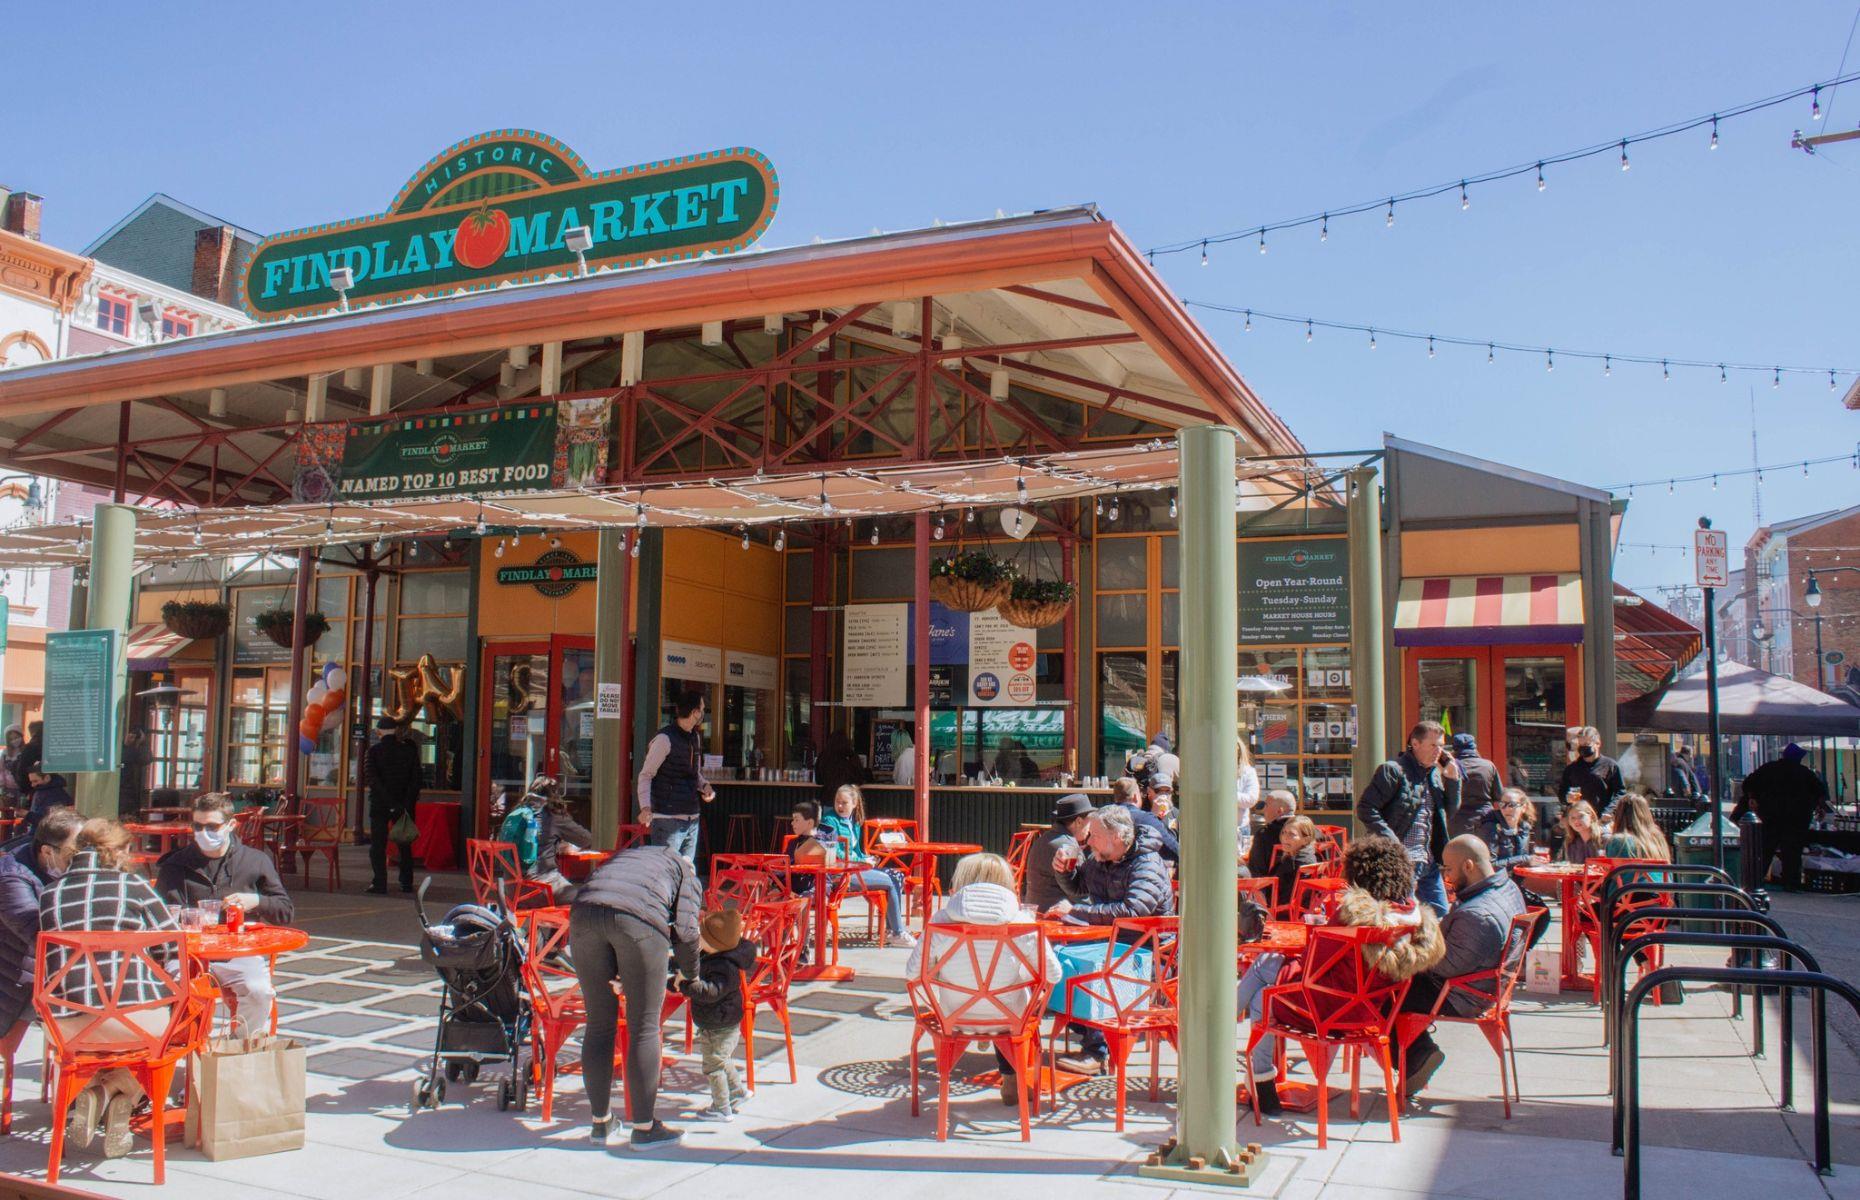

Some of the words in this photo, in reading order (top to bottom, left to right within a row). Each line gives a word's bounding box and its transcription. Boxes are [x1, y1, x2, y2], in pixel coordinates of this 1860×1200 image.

[424, 147, 554, 196] HISTORIC
[261, 229, 458, 299] FINDLAY
[504, 177, 749, 258] MARKET
[402, 445, 441, 456] FINDLAY
[449, 441, 488, 453] MARKET
[340, 475, 399, 494] NAMED
[403, 473, 434, 490] TOP
[439, 472, 455, 487] 10
[458, 467, 500, 486] BEST
[503, 464, 549, 483] FOOD
[1704, 534, 1717, 545] NO
[1697, 546, 1725, 558] PARKING
[1706, 558, 1717, 566] ANY
[500, 569, 551, 582] FINDLAY
[1705, 565, 1719, 574] TIME
[1255, 578, 1282, 590] Open
[1283, 576, 1343, 587] Year-Round
[1314, 611, 1337, 619] HOURS
